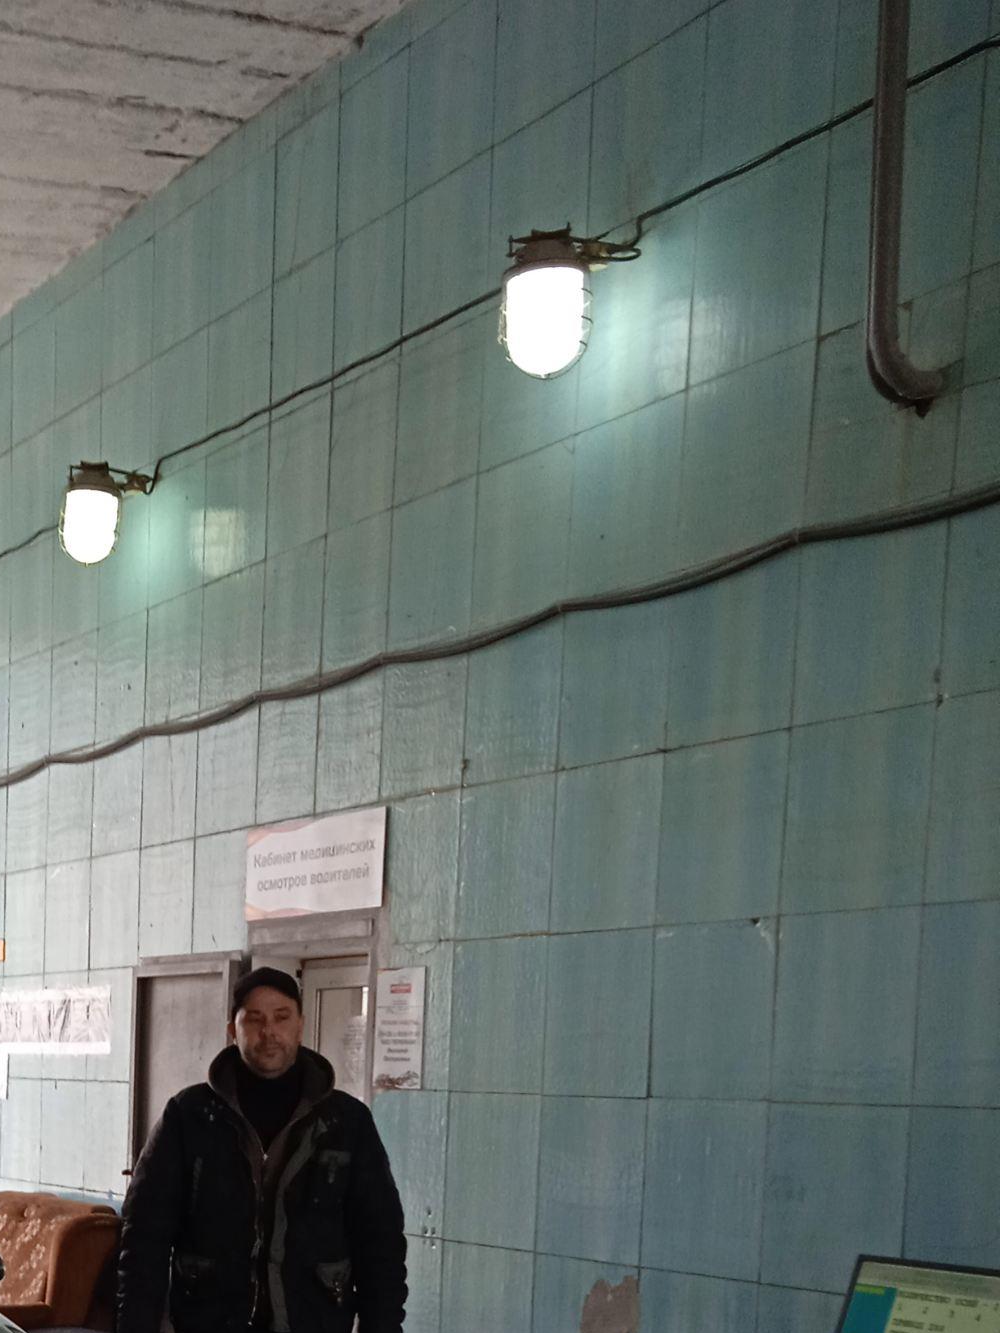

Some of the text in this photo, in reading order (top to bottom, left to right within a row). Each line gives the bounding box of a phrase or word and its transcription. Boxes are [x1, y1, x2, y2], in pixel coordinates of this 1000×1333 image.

[253, 839, 376, 868] Кабинет медицинских
[257, 862, 370, 891] осмотров водителей
